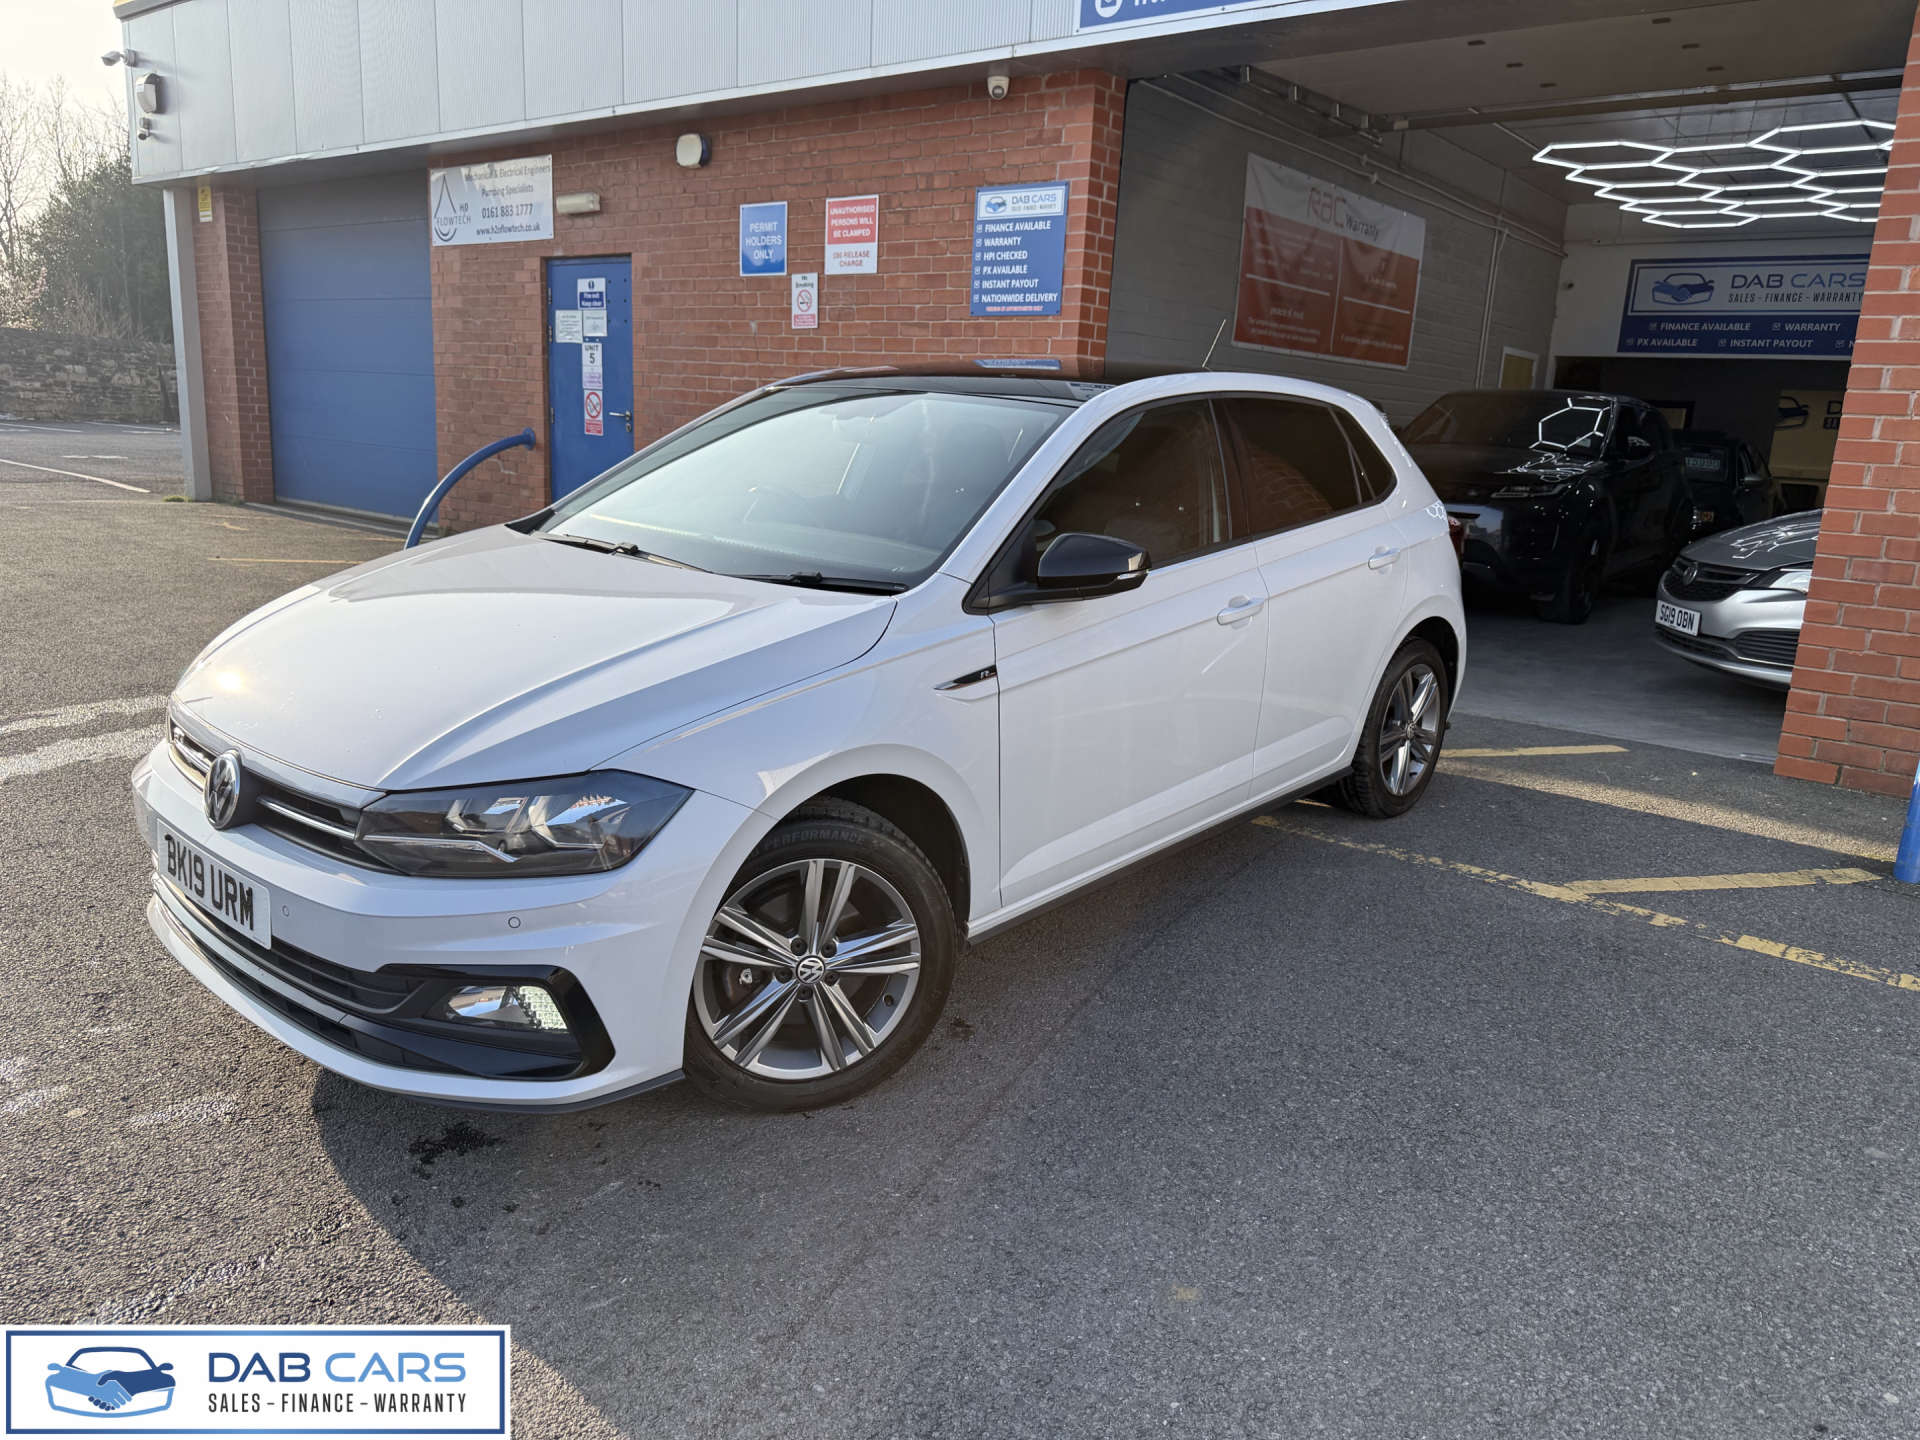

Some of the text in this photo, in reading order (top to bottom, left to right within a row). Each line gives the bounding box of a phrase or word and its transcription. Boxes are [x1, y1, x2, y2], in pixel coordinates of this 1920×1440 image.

[1011, 193, 1057, 205] DAB CARS
[481, 203, 533, 219] 0161 883 1777
[436, 215, 471, 226] FLOWTECH
[859, 216, 873, 225] WILL
[750, 221, 778, 233] PERMIT
[985, 220, 1051, 233] FINANCE AVAILABLE
[1345, 214, 1379, 241] Warranty
[833, 228, 871, 238] BE CLAMPED
[745, 235, 783, 247] HOLDERS
[984, 236, 1021, 247] WARRANTY
[753, 249, 774, 260] ONLY
[984, 251, 1028, 261] HPI CHECKED
[982, 265, 1028, 275] PX AVAILABLE
[982, 278, 1039, 289] INSTANT PAYOUT
[1730, 272, 1866, 289] DAB CARS
[981, 292, 1058, 303] NATIONWIDE DELIVERY
[1728, 293, 1756, 304] SALES
[1765, 292, 1803, 303] FINANCE
[1813, 292, 1863, 303] WARRANTY
[1660, 323, 1841, 332] FINANCE AVAILABLE WARRANTY
[1637, 339, 1814, 348] PX AVAILABLE INSTANT PAYOUT
[589, 353, 596, 364] 5
[1659, 604, 1695, 631] SG19 OBN
[764, 829, 865, 850] PERFORMANCE
[166, 835, 254, 931] BK19 URM
